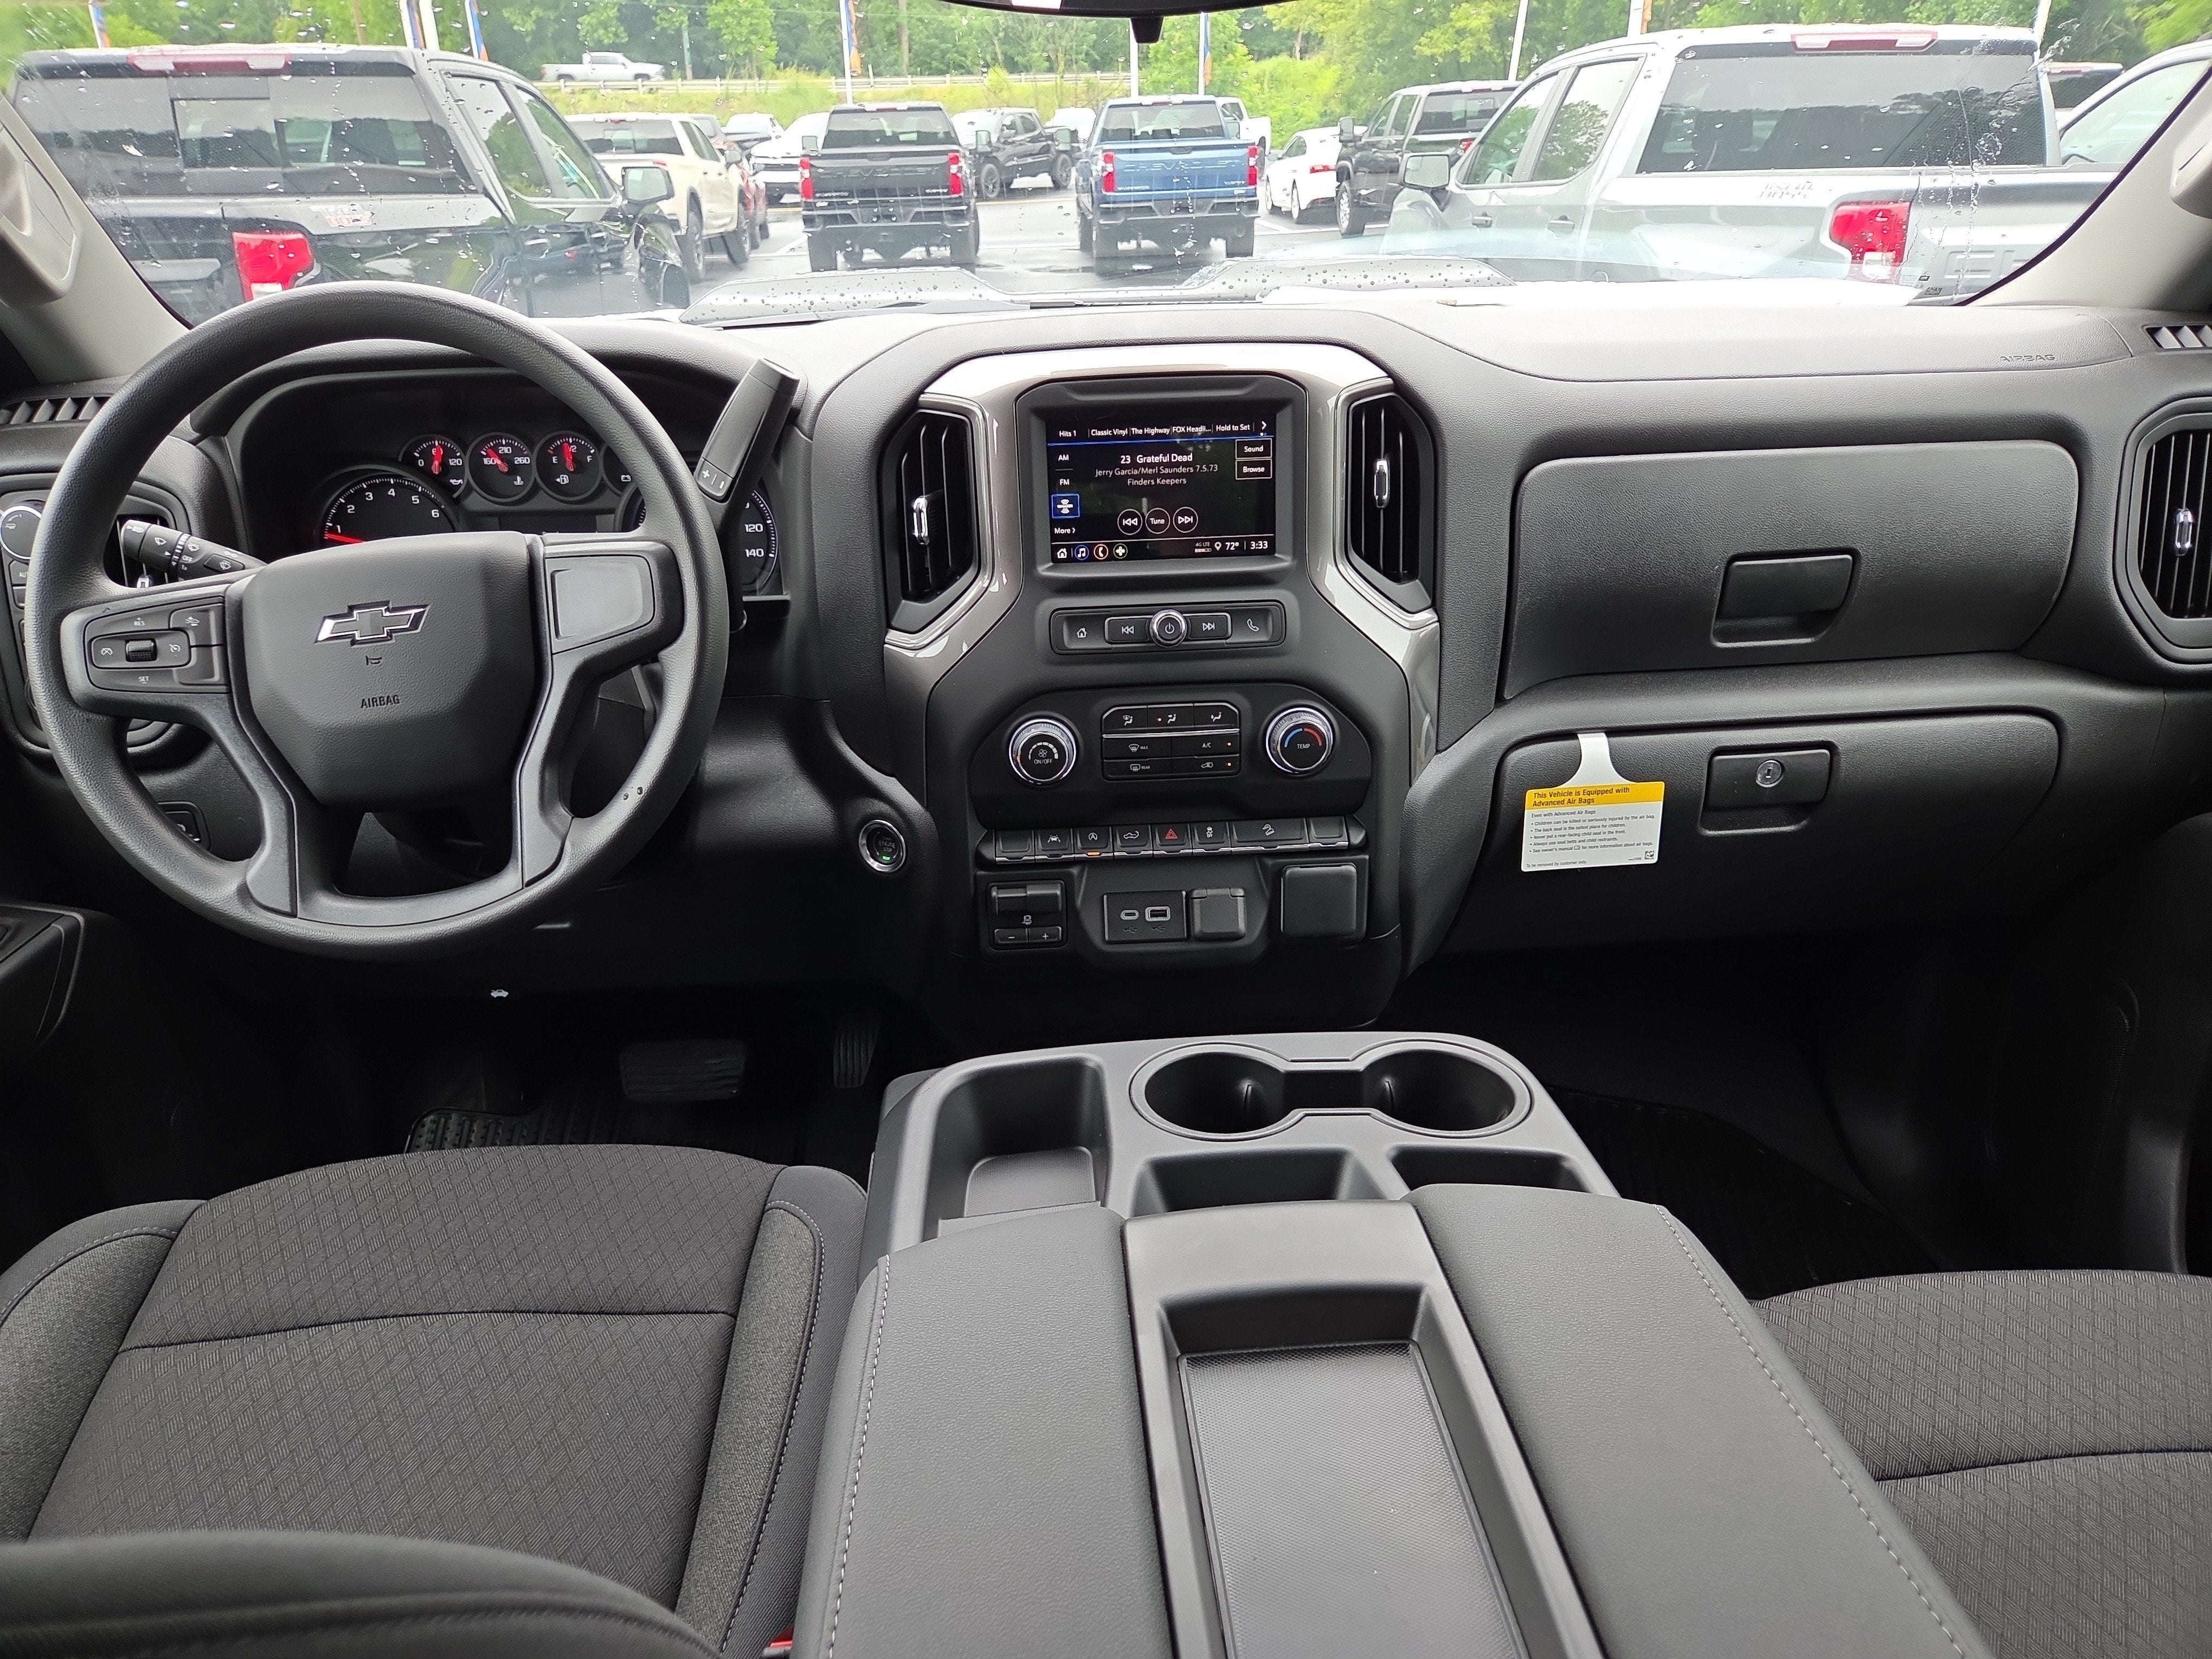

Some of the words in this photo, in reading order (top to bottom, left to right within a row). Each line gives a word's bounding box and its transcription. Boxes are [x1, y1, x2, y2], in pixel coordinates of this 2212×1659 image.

[2000, 354, 2055, 362] AIRBAG
[1113, 428, 1128, 436] Vinyl
[1144, 426, 1170, 436] Highway
[499, 446, 512, 454] 210
[418, 459, 424, 467] 0
[1120, 455, 1131, 464] 23
[1136, 453, 1169, 464] Grateful
[1171, 453, 1193, 462] Dead
[1095, 468, 1113, 478] Jerry
[1115, 466, 1158, 475] Garcia/Merl
[1160, 465, 1194, 474] Saunders
[1195, 464, 1218, 473] 7.5.73
[1127, 478, 1155, 486] Finders
[1156, 477, 1187, 486] Keepers
[365, 492, 374, 501] 3
[388, 488, 396, 497] 4
[411, 495, 420, 504] 5
[347, 505, 356, 513] 2
[431, 509, 440, 518] 6
[336, 525, 341, 533] 1
[744, 523, 764, 533] 120
[1250, 541, 1268, 550] 3:33
[745, 548, 764, 557] 140
[361, 695, 400, 709] AIRBAG
[1549, 790, 1572, 798] Vehicle
[1583, 787, 1613, 797] Equipped
[1533, 799, 1565, 807] Advanced
[1578, 797, 1595, 805] Bags
